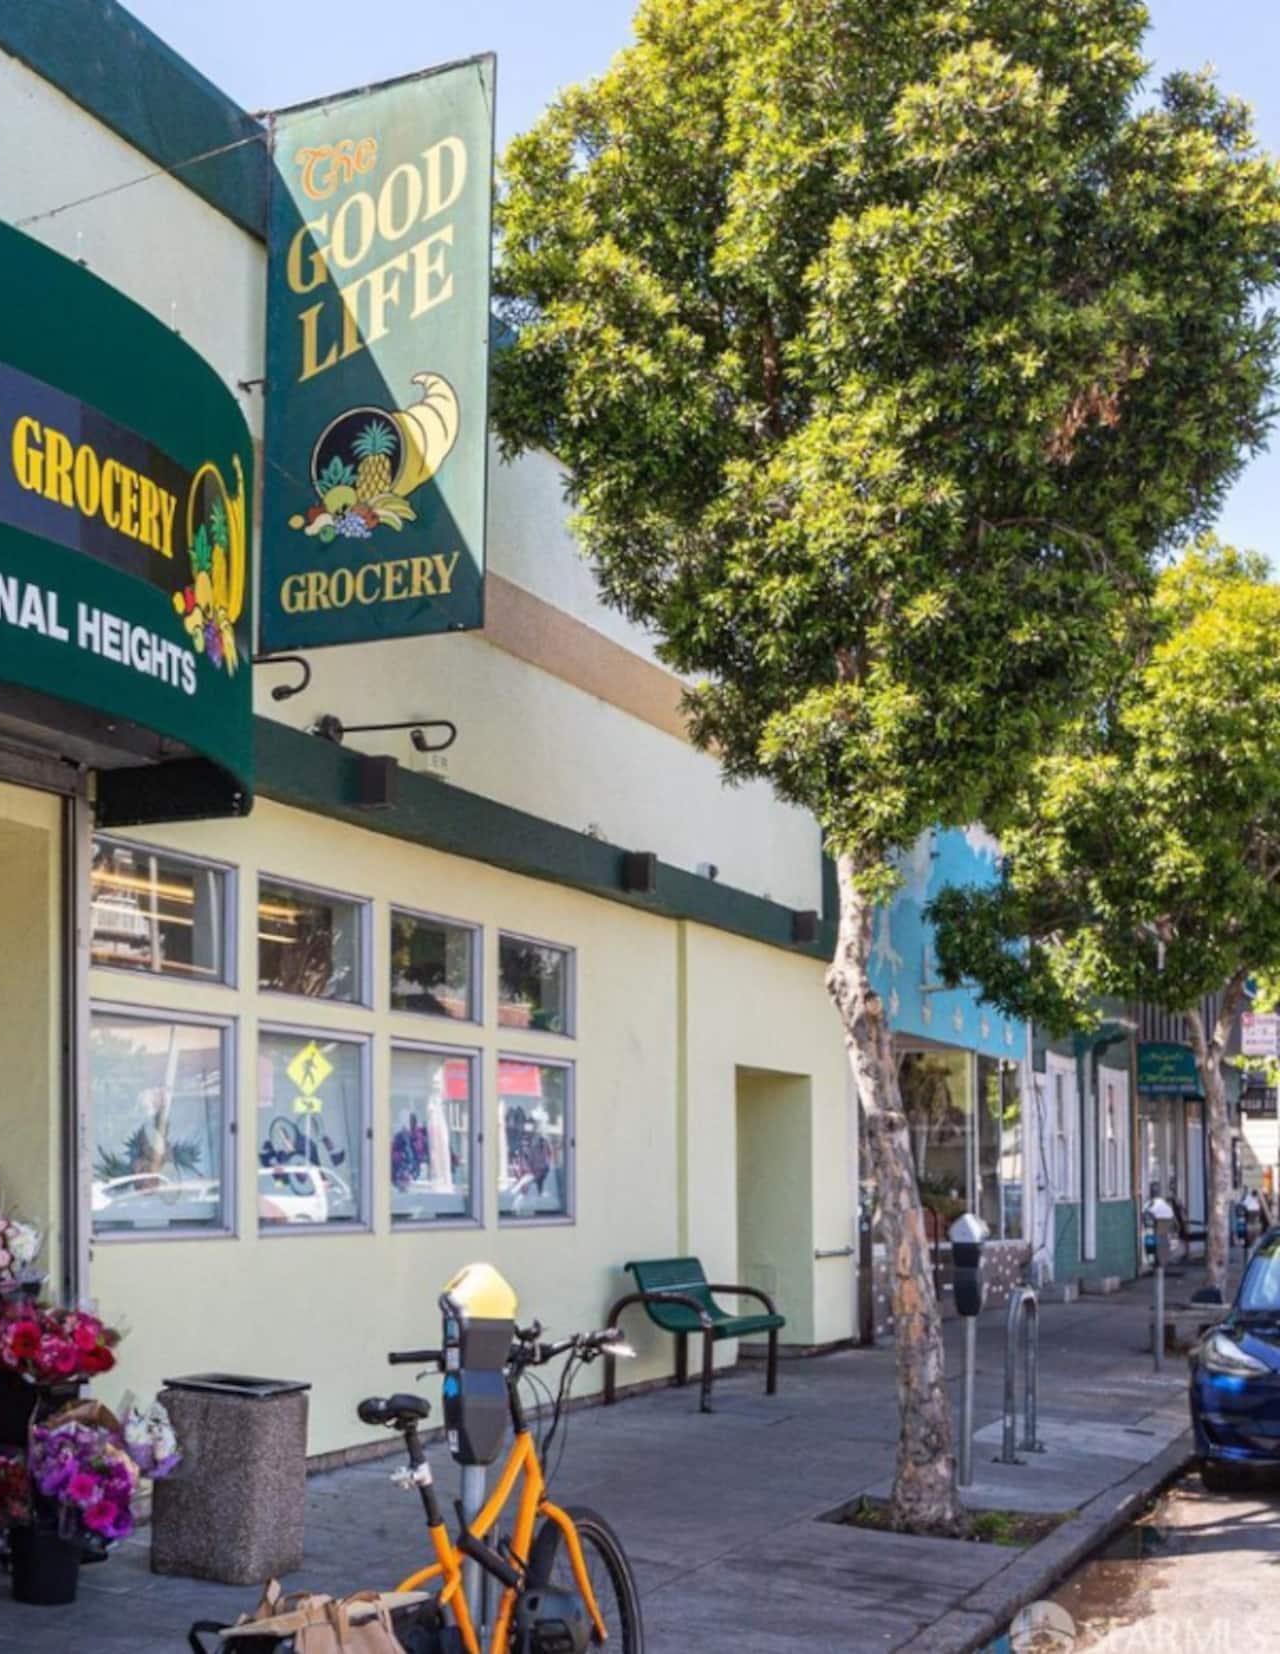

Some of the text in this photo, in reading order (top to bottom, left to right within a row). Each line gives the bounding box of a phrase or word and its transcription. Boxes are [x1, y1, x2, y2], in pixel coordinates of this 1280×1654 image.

[286, 134, 468, 295] GOOD
[294, 134, 378, 201] The
[298, 224, 455, 383] LIFE
[11, 414, 178, 560] GROCERY
[280, 551, 461, 614] GROCERY
[76, 601, 197, 696] HEIGHTS
